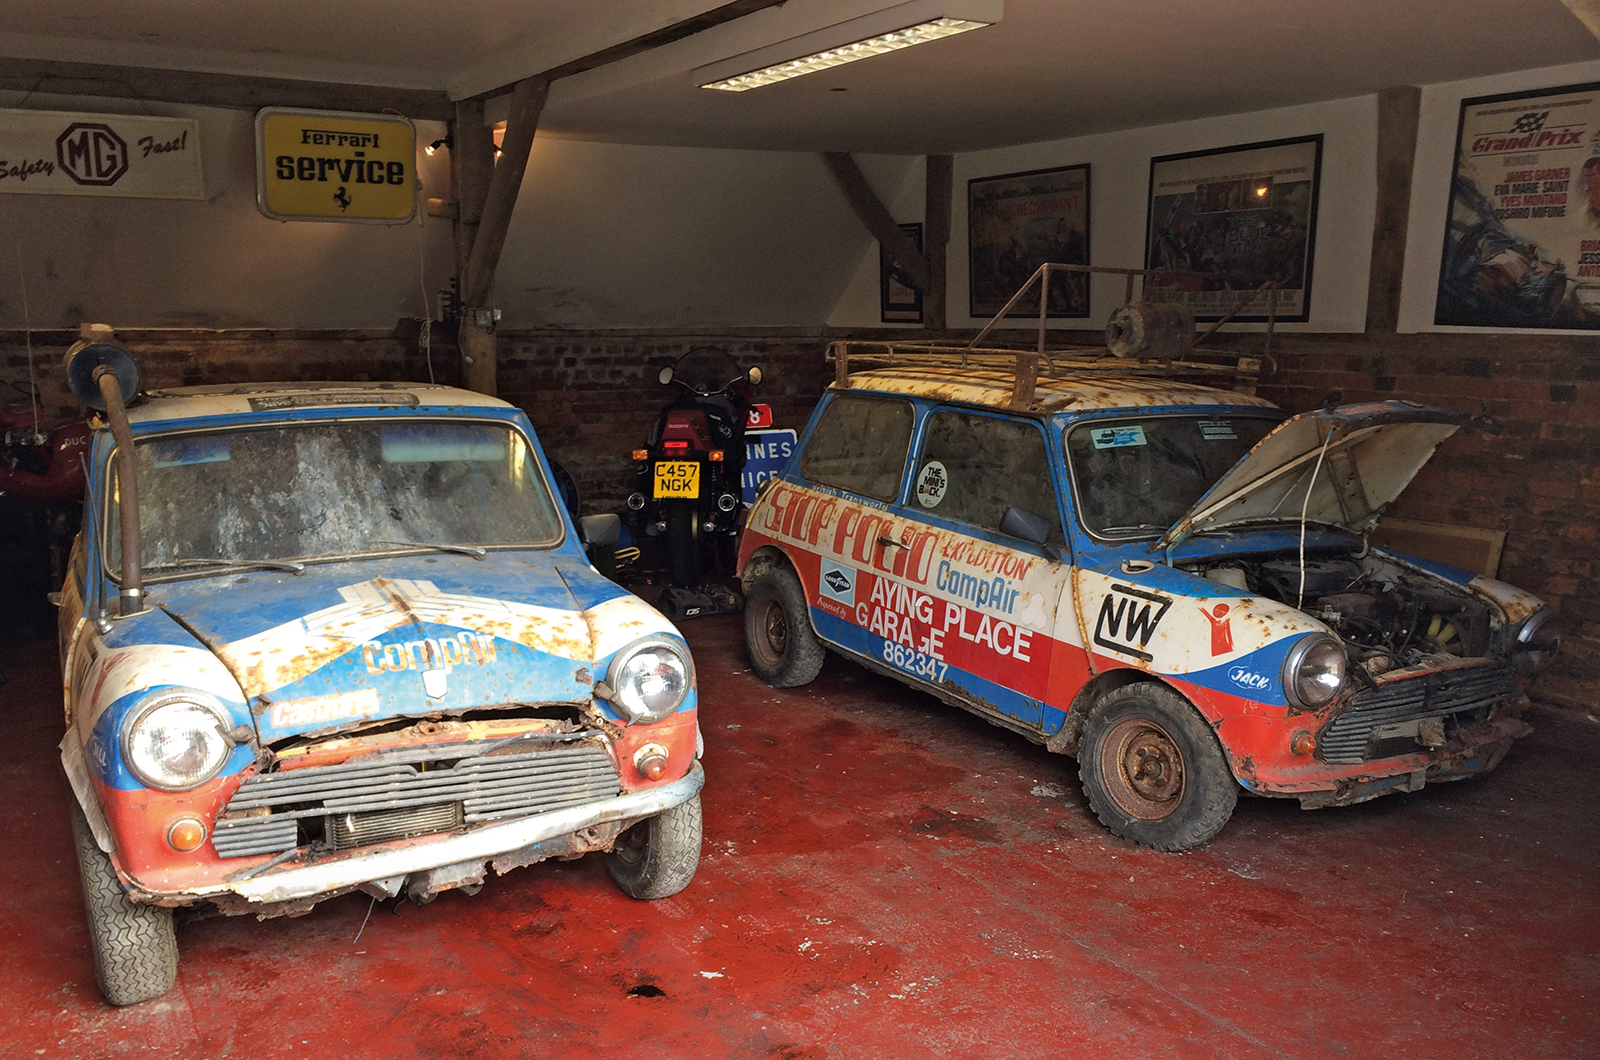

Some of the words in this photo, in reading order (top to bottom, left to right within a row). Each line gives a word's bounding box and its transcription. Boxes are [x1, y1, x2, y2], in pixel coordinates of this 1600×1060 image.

[300, 129, 380, 149] Ferrari
[1471, 133, 1535, 153] Grand
[1536, 129, 1586, 148] Prix
[0, 159, 55, 182] Safety
[137, 130, 188, 158] Fast!
[67, 131, 118, 178] MG
[276, 152, 405, 187] service
[1504, 170, 1533, 184] JAMES
[1534, 167, 1571, 181] GARNER
[1494, 184, 1511, 196] EVA
[1512, 182, 1540, 195] MARIE
[1542, 180, 1570, 194] SAINT
[1500, 195, 1522, 208] YVES
[656, 463, 697, 478] C457
[660, 478, 692, 492] NGK
[928, 467, 942, 477] THE
[765, 487, 837, 547] STOP
[936, 560, 1021, 615] CompAir
[870, 575, 934, 625] AYING
[944, 601, 1034, 663] PLACE
[1099, 593, 1167, 647] NW
[362, 630, 498, 676] CompAir
[883, 639, 949, 684] 862347
[1230, 669, 1270, 689] JACK
